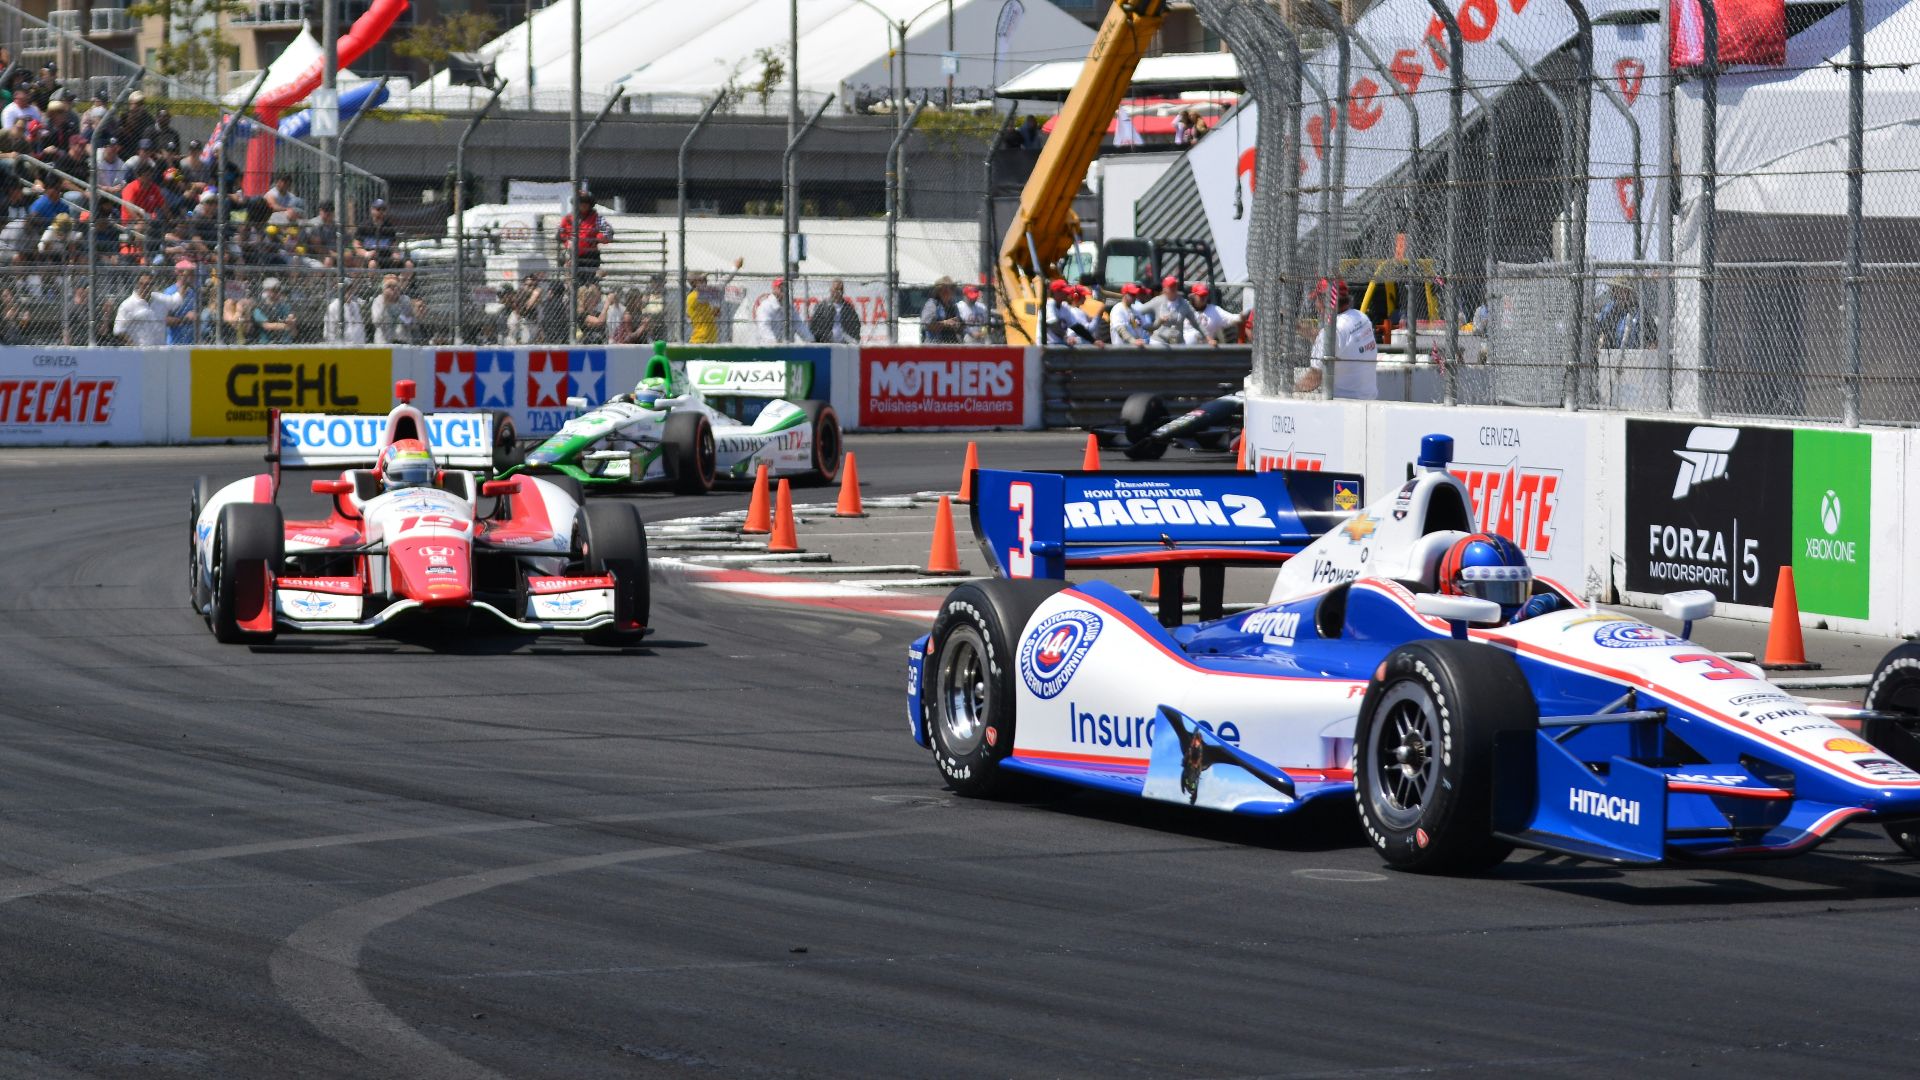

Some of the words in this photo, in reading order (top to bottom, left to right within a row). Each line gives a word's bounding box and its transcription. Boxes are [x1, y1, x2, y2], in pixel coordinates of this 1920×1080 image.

[32, 355, 78, 367] CERVEZA
[703, 368, 787, 384] CINSAY
[226, 364, 359, 406] GEHL
[870, 361, 1014, 397] MOTHERS
[0, 375, 115, 423] TECATE
[870, 399, 918, 413] Polishes
[923, 399, 961, 412] Waxes
[965, 398, 1014, 412] Cleaners
[1271, 415, 1295, 434] CERVEZA
[1479, 426, 1521, 447] CERVEZA
[1083, 490, 1113, 498] HOW
[1115, 490, 1132, 498] TO
[1132, 489, 1169, 497] TRAIN
[1170, 488, 1203, 497] YOUR
[1064, 499, 1225, 529] RAGON
[1222, 494, 1276, 528] 2
[1009, 481, 1034, 579] 3
[1650, 524, 1728, 563] FORZA
[1742, 538, 1760, 585] 5
[1805, 537, 1833, 558] XBOX
[1833, 541, 1856, 562] ONE
[1312, 559, 1360, 584] V-Power
[1240, 606, 1300, 647] verizon
[1038, 630, 1074, 656] AAA
[1570, 787, 1640, 826] HITACHI
